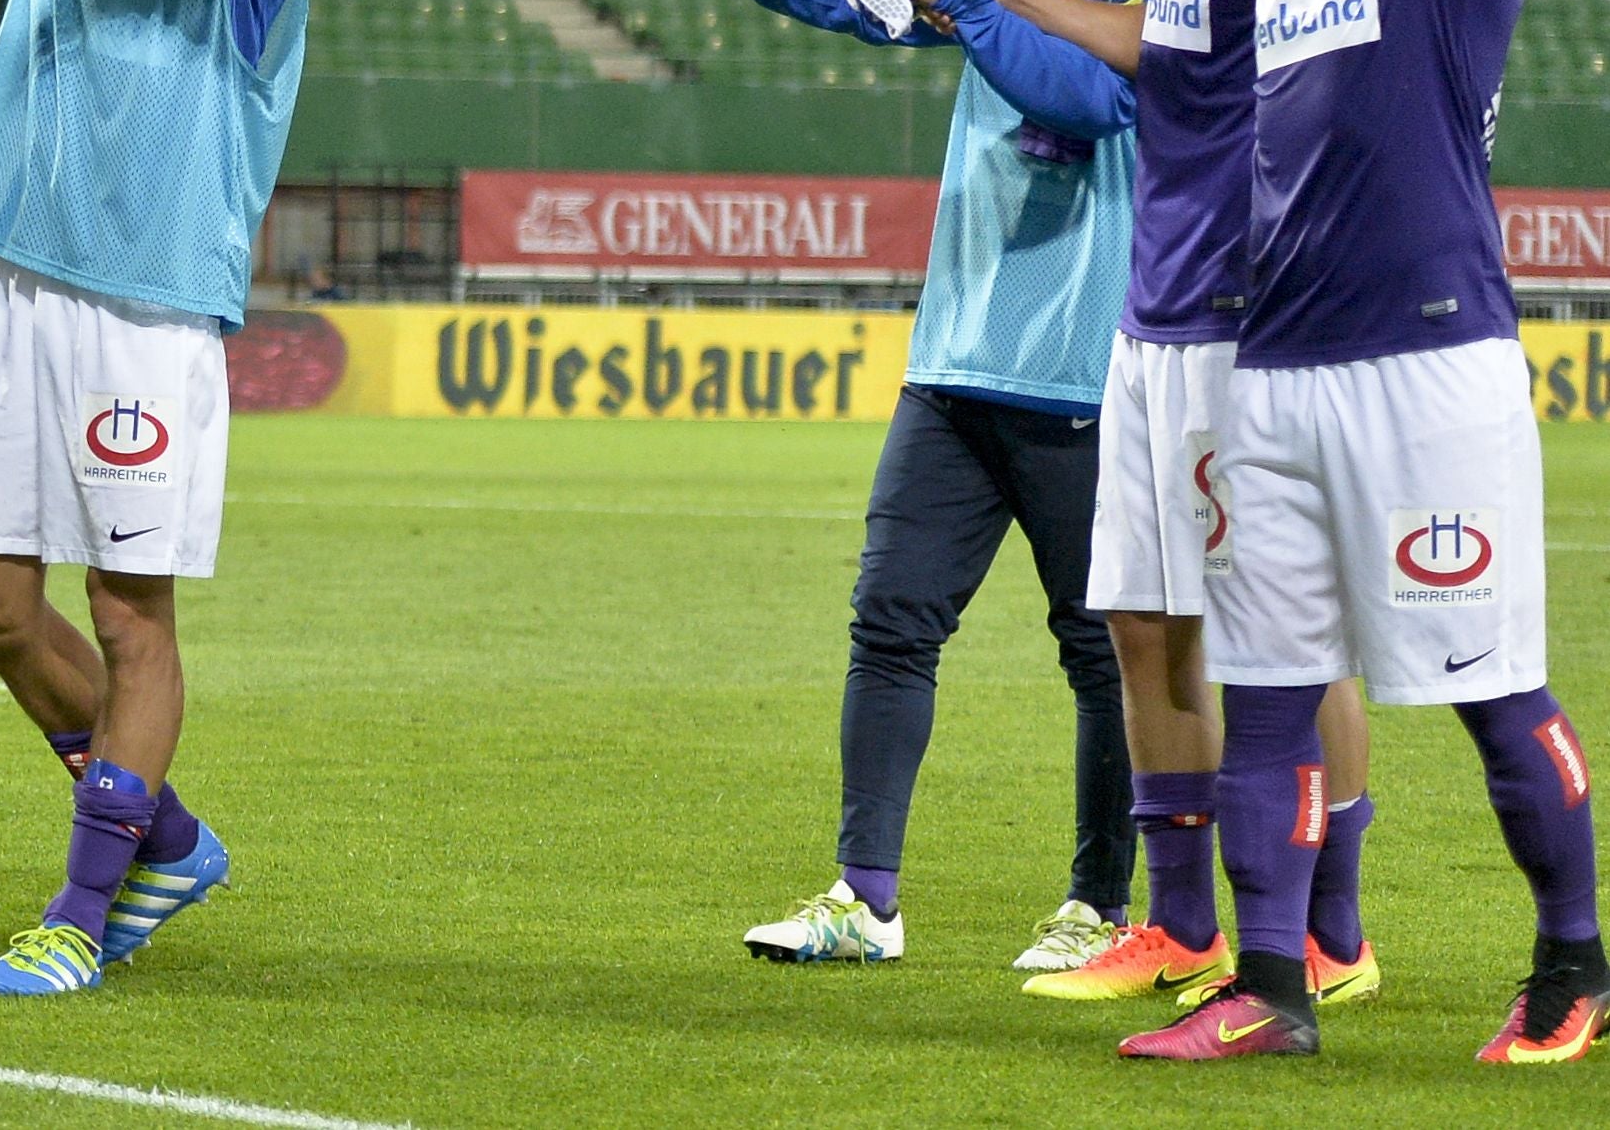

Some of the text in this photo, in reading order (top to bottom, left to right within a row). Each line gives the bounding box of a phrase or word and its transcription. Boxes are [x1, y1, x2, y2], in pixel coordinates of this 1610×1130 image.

[600, 188, 869, 258] GENERALI
[436, 318, 867, 418] Wiesbauer
[83, 466, 167, 485] HARREITHER
[1394, 587, 1492, 603] HARREITHER
[1305, 770, 1324, 843] wienholding
